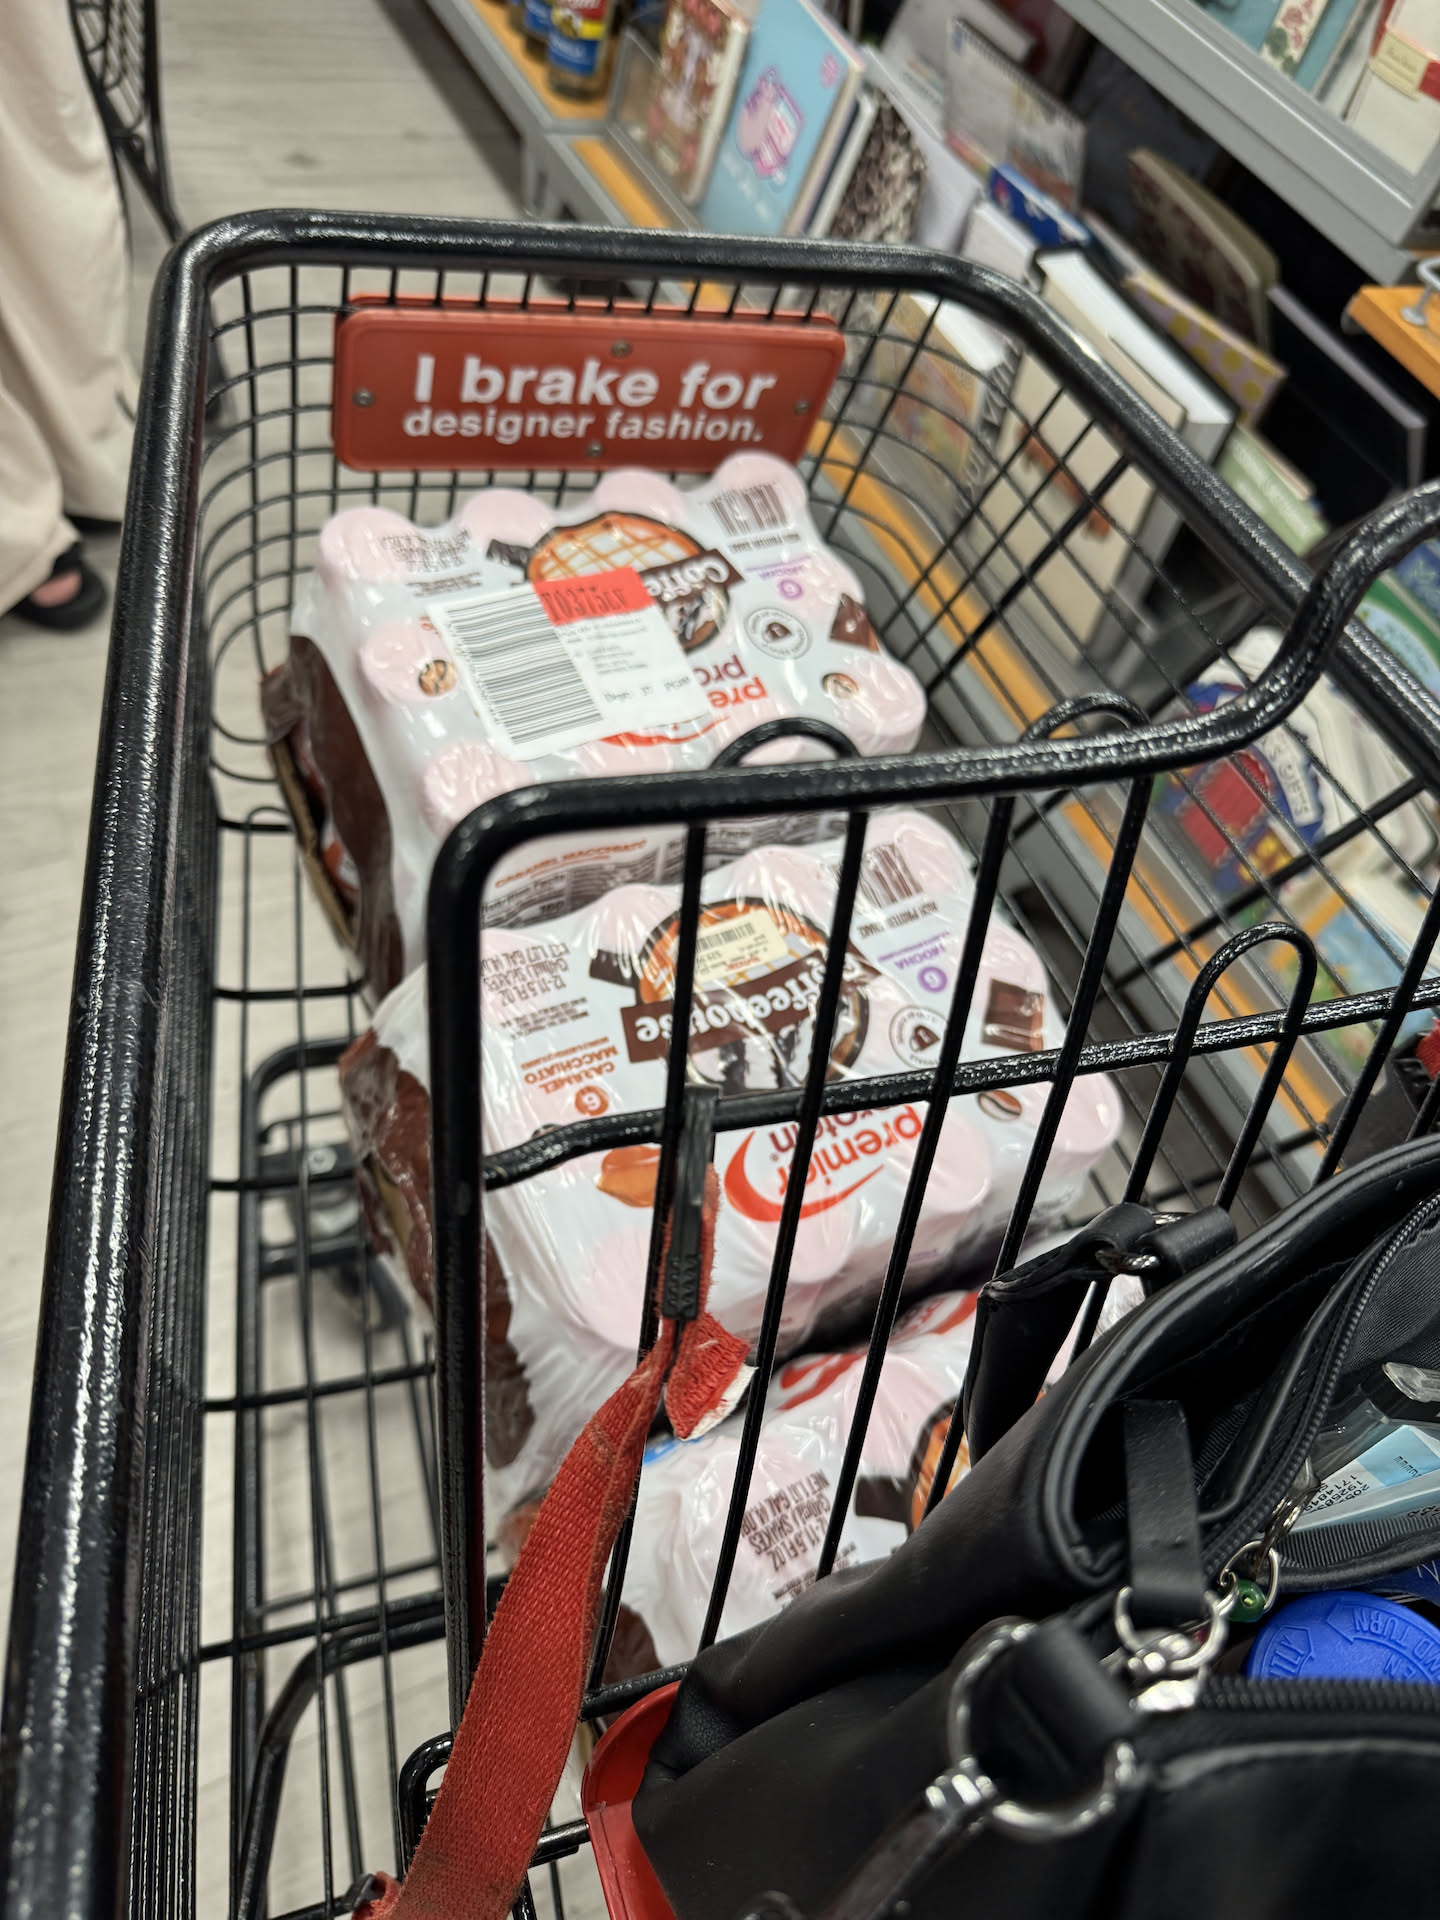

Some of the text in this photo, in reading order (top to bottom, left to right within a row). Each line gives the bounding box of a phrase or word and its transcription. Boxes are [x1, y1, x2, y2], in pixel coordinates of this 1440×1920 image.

[413, 353, 777, 410] I brake for
[403, 408, 764, 445] designer fashion.
[524, 1045, 619, 1084] MACCHIATO
[539, 1061, 615, 1095] CARAMEL
[748, 1513, 793, 1555] SHAKES
[1353, 1607, 1411, 1649] TURN
